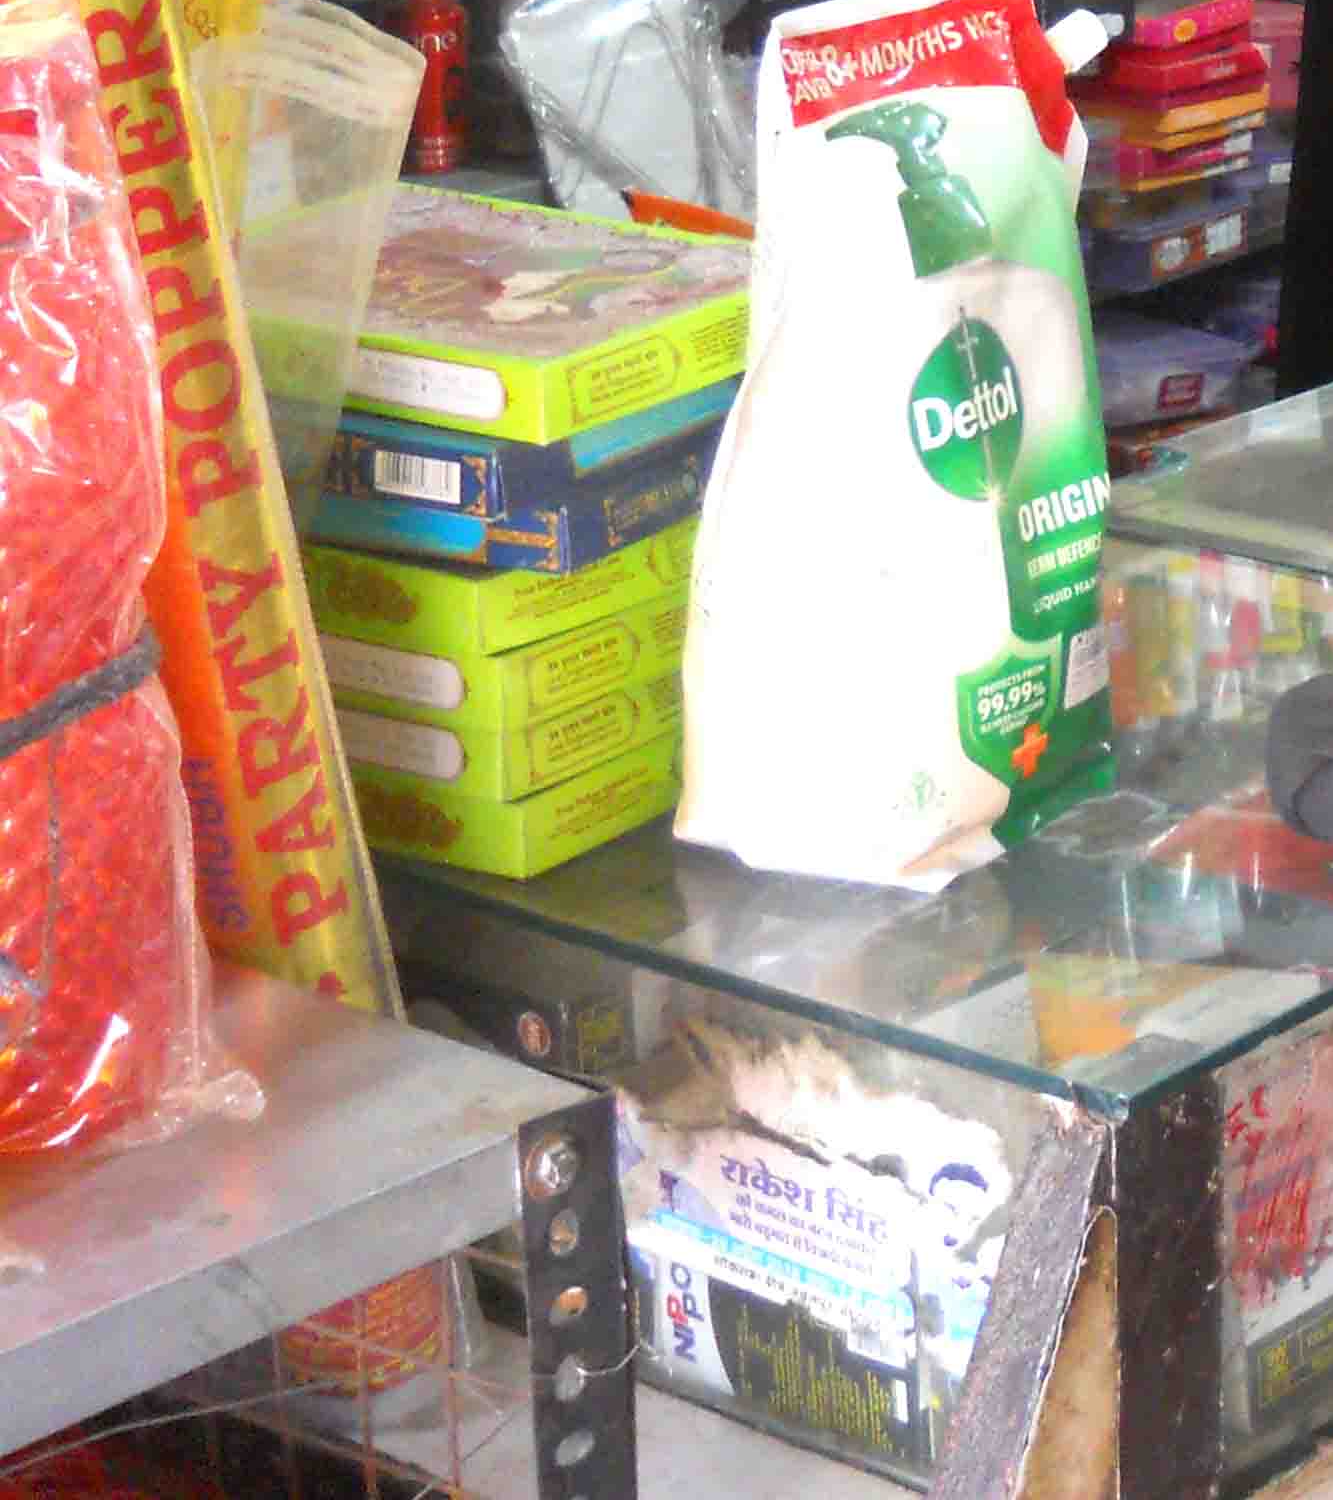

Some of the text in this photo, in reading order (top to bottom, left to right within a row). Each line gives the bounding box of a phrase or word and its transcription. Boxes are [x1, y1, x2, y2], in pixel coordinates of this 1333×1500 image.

[862, 22, 962, 78] MONTHS
[912, 366, 1018, 453] Dettol
[977, 680, 1047, 722] 99.99%
[197, 551, 351, 948] PARTY
[720, 1155, 816, 1213] राकेश
[667, 1262, 704, 1362] NIPPO
